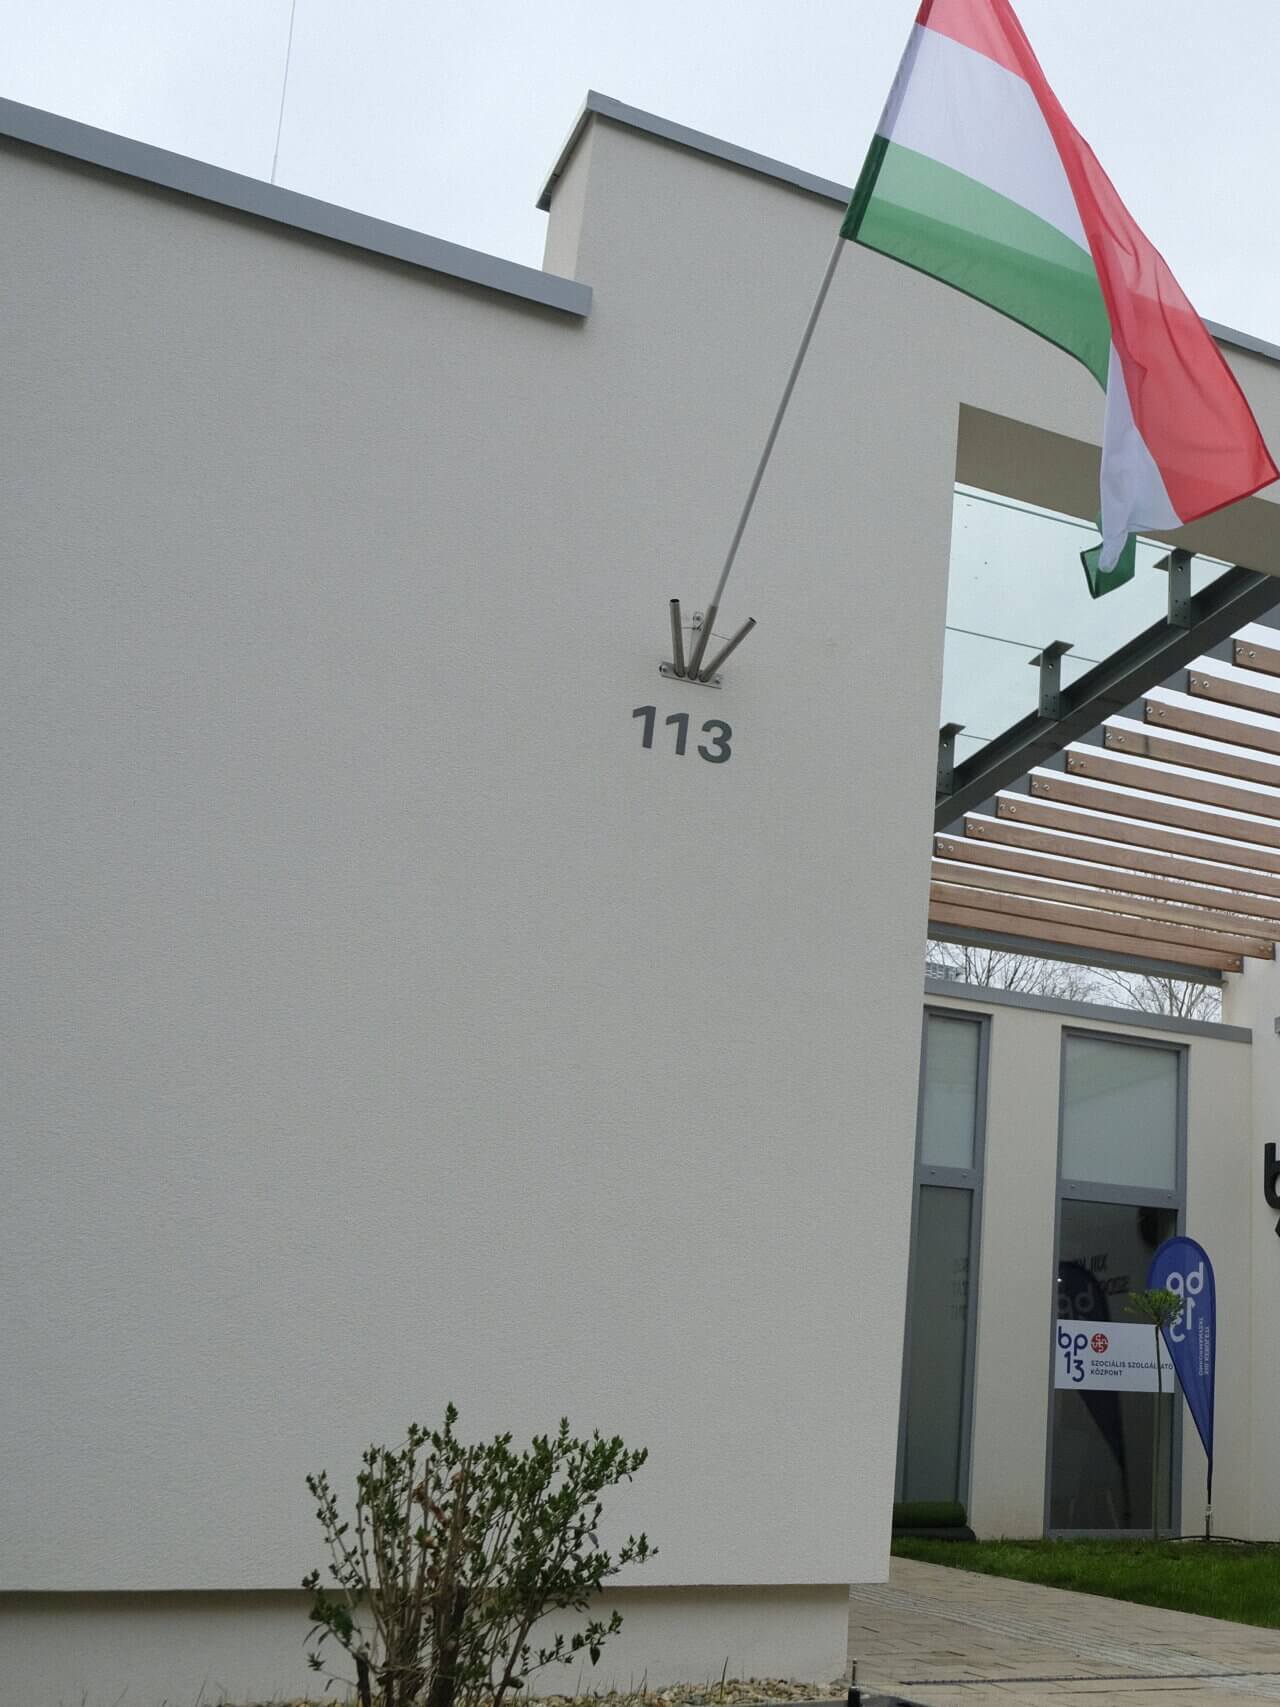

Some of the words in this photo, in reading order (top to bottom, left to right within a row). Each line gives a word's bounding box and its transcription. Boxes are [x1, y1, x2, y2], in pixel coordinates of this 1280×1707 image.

[632, 705, 732, 764] 113
[1058, 1326, 1088, 1356] bp
[1064, 1351, 1085, 1382] 13
[1127, 1360, 1174, 1370] SZOLGÁLATÓ
